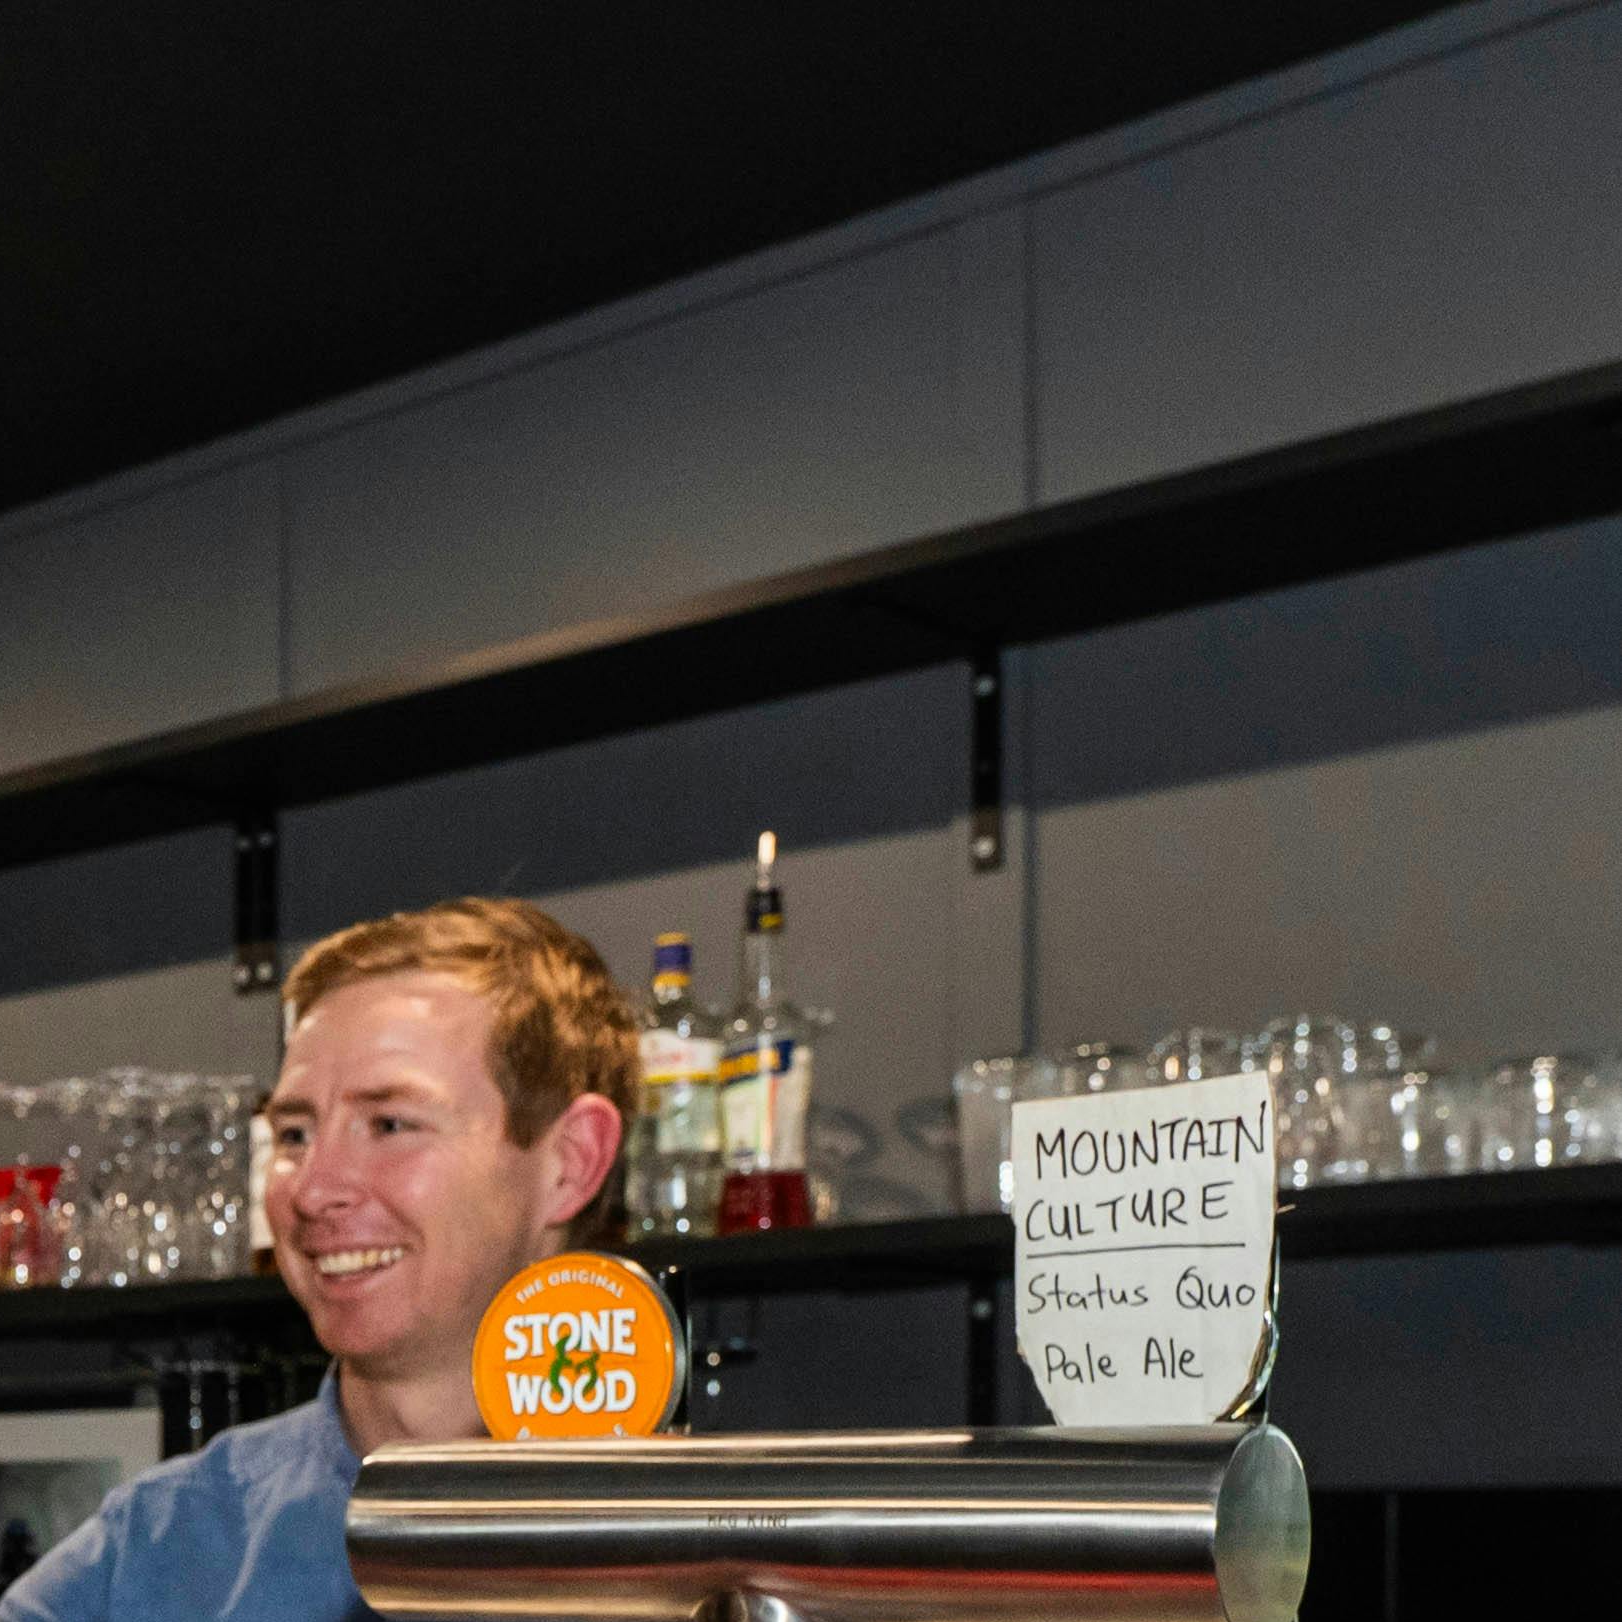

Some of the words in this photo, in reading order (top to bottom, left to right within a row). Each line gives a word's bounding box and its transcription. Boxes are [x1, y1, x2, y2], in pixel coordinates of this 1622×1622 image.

[1035, 1099, 1269, 1181] MOUNTAIN
[1025, 1181, 1235, 1243] CULTURE
[515, 1280, 546, 1305] THE
[547, 1270, 626, 1299] ORIGINAL
[1026, 1271, 1150, 1316] Status
[1174, 1264, 1257, 1312] Quo
[503, 1307, 637, 1362] STONE
[1044, 1339, 1120, 1387] Pale
[1142, 1335, 1205, 1380] Ale
[505, 1368, 638, 1417] WOOD
